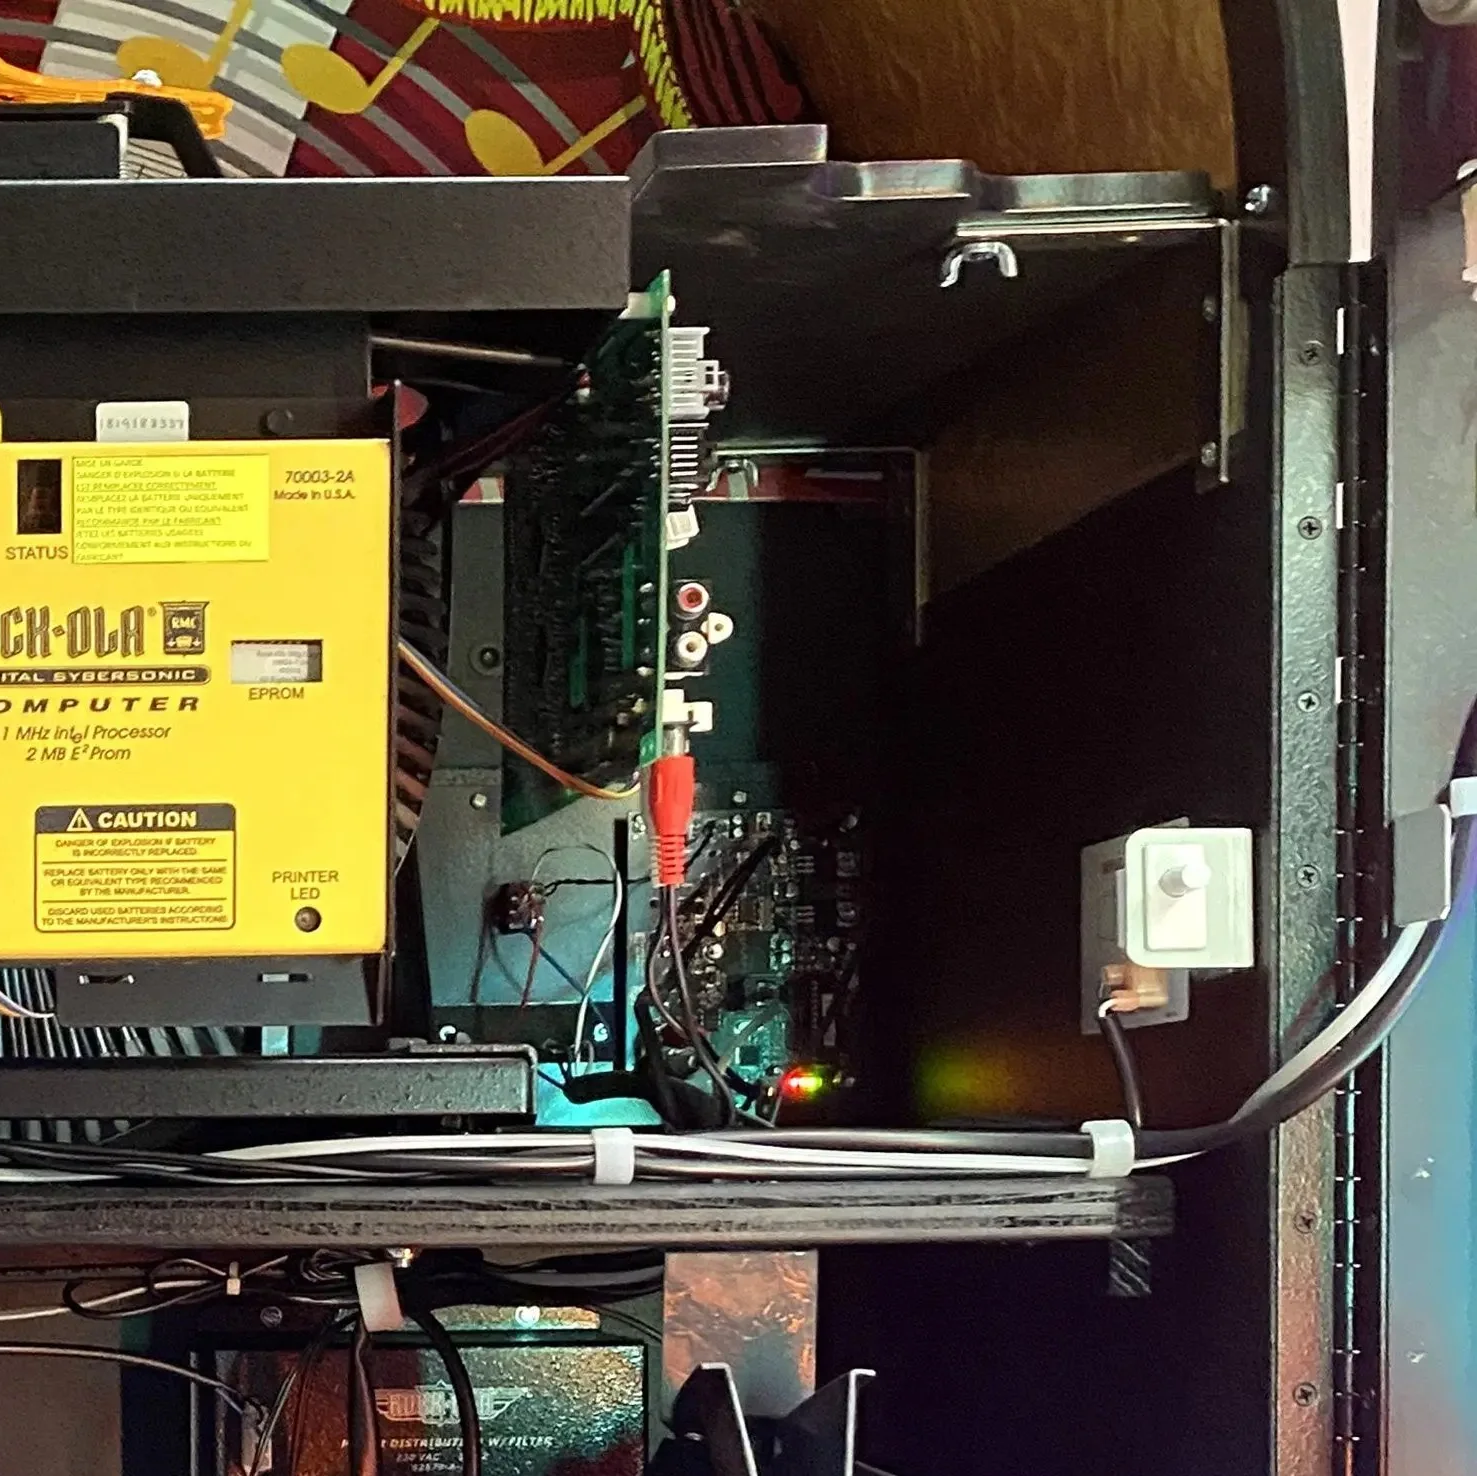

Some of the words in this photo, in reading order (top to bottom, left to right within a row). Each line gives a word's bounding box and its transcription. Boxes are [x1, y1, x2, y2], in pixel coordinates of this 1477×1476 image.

[5, 546, 69, 560] STATUS
[52, 669, 197, 683] SYBERSONIC
[248, 686, 305, 701] EPROM
[15, 726, 50, 741] MHz
[91, 725, 172, 741] Processor
[25, 747, 37, 761] 2
[40, 747, 67, 761] MB
[97, 810, 197, 828] CAUTION
[272, 871, 340, 884] PRINTER
[290, 887, 320, 900] LED
